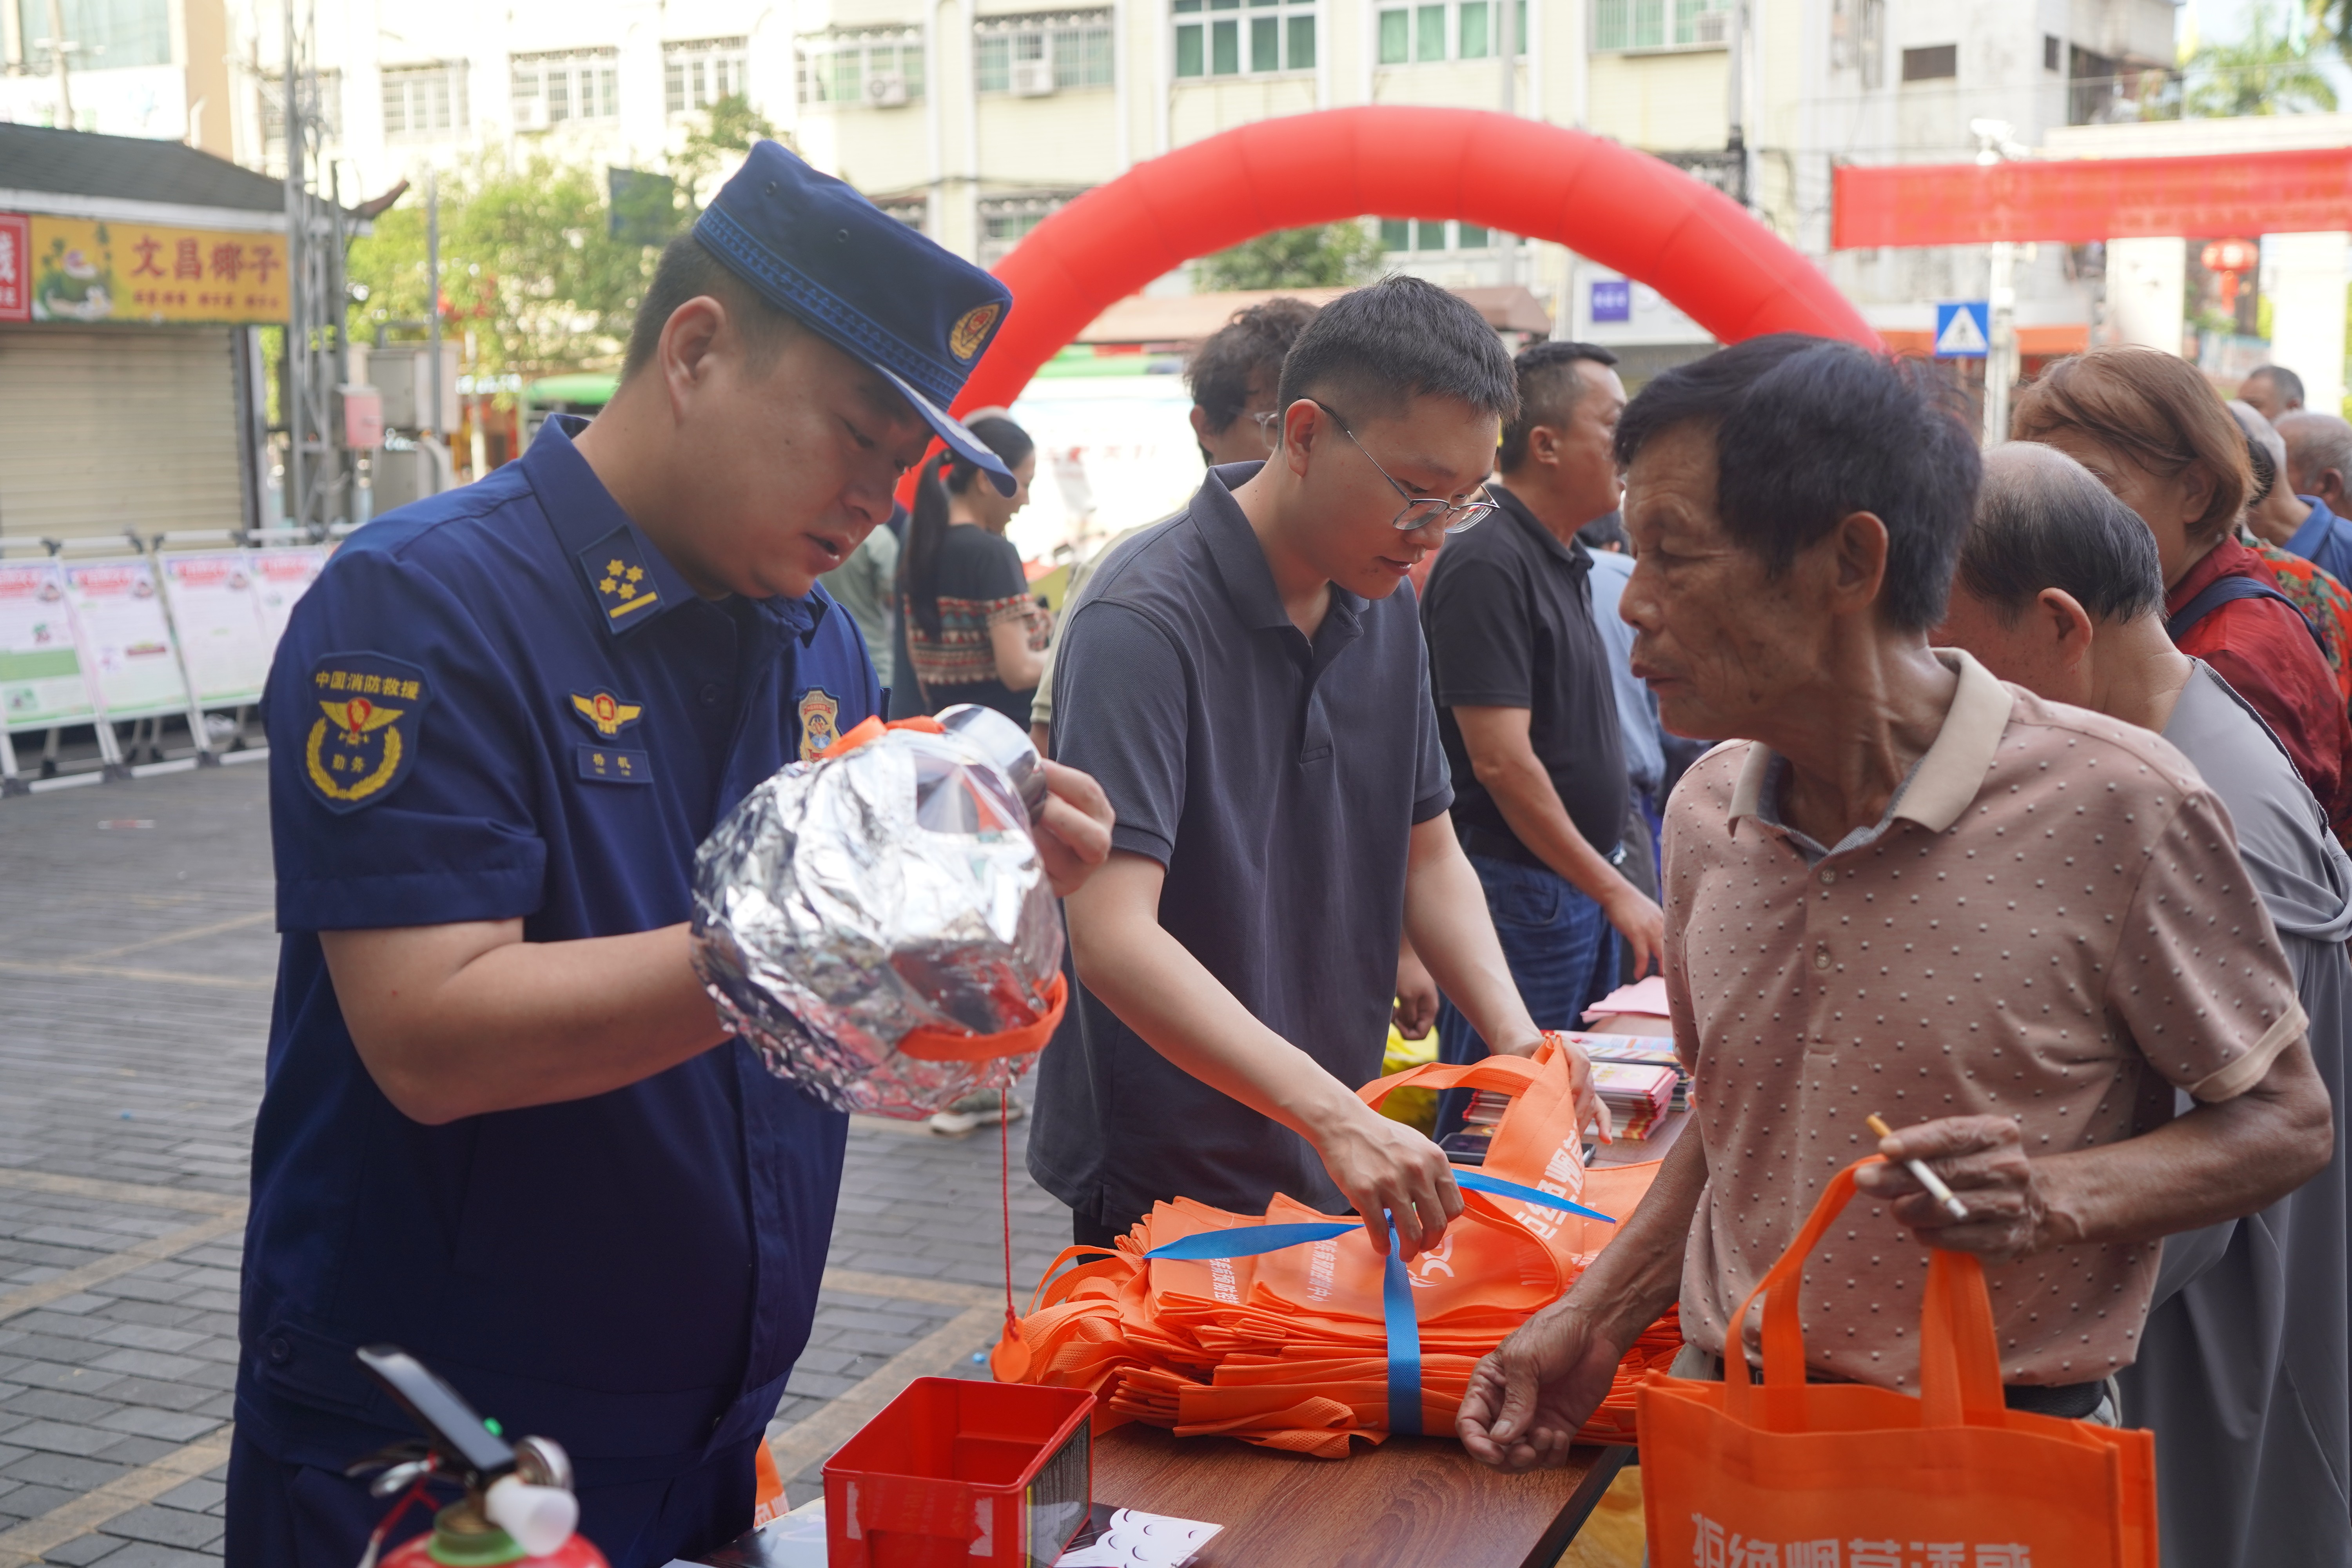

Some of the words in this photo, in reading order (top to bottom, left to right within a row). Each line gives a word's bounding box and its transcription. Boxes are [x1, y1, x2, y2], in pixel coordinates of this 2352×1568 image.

[131, 233, 281, 286] 文昌椰子
[316, 670, 420, 701] 中国消防救援
[332, 753, 366, 773] 勤务
